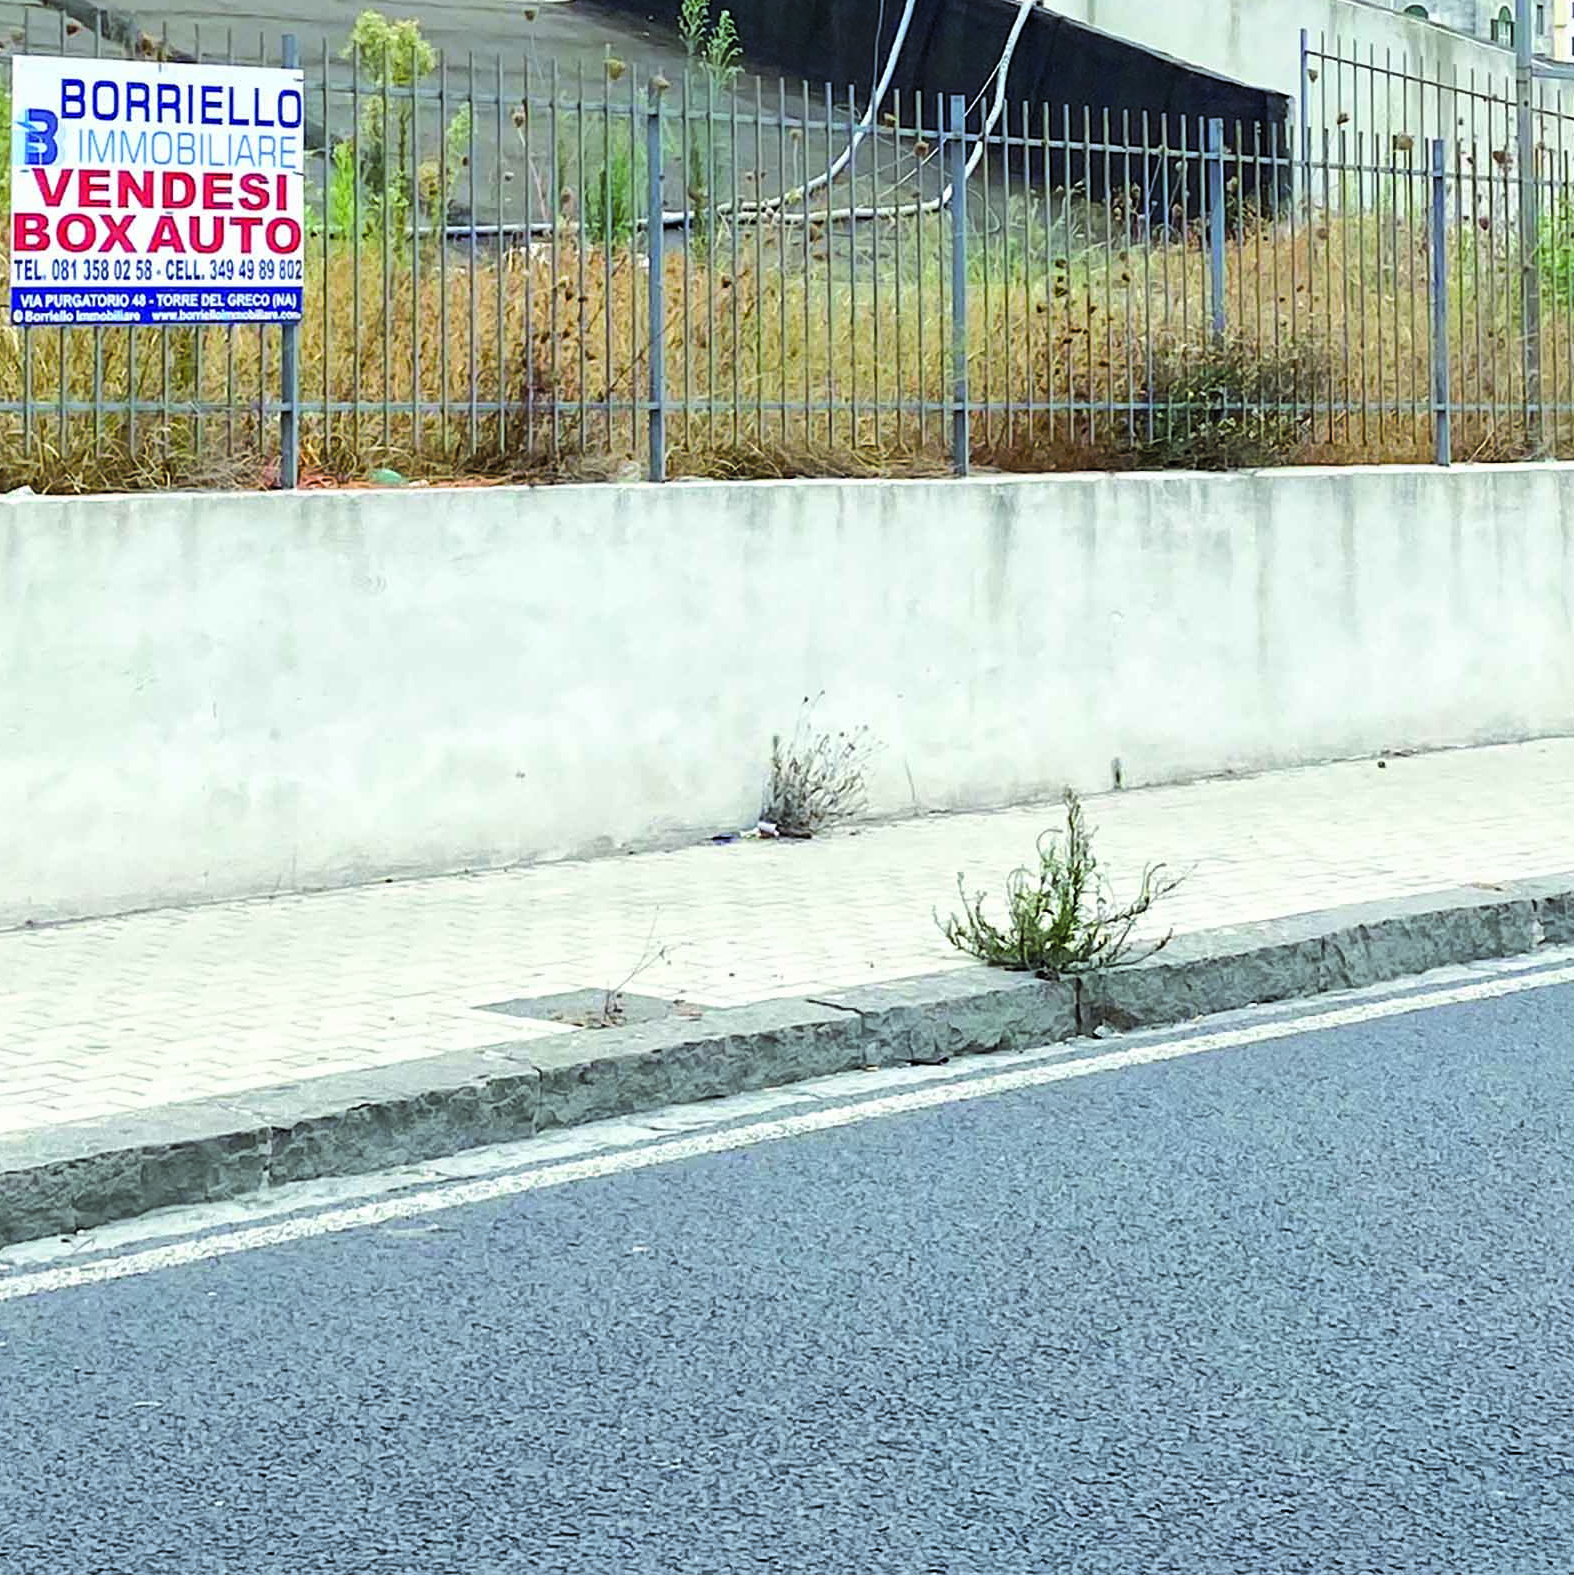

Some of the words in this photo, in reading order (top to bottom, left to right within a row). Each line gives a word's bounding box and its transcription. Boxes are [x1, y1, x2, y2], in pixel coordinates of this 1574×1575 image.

[61, 78, 302, 128] BORRIELLO
[79, 129, 297, 168] IMMOBILIARE
[32, 168, 288, 211] VENDESI
[14, 213, 138, 253] BOX
[146, 214, 302, 254] AUTO
[14, 259, 46, 280] TEL.
[51, 259, 77, 280] 081
[83, 259, 110, 280] 358
[114, 259, 131, 280] 02
[136, 259, 153, 280] 58
[166, 259, 205, 281] CELL.
[210, 259, 234, 281] 349
[239, 259, 255, 281] 49
[259, 259, 275, 281] 89
[279, 259, 303, 281] 802
[20, 293, 43, 307] VIA
[45, 293, 130, 307] PURGATORIO
[131, 293, 146, 307] 48
[156, 293, 199, 307] TORRE
[201, 293, 225, 307] DEL
[227, 293, 270, 307] GRECO
[272, 293, 297, 309] (NA)
[25, 309, 74, 322] Borriello
